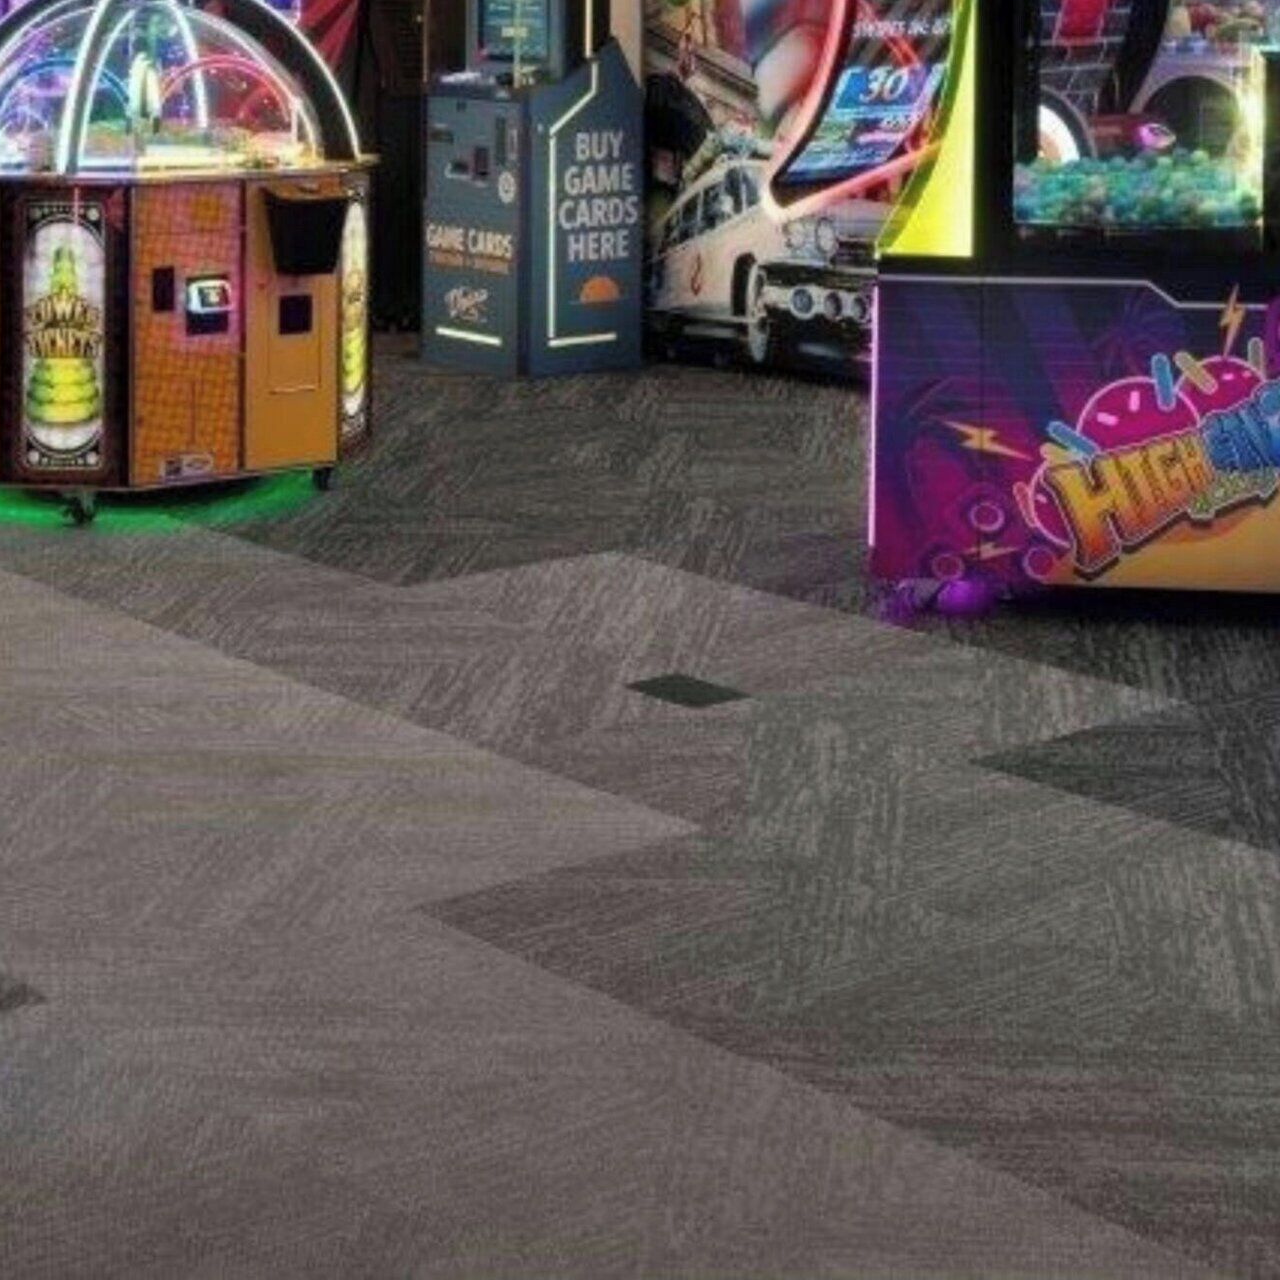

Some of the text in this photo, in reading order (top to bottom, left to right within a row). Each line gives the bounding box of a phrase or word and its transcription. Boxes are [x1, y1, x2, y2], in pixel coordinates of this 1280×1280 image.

[859, 65, 909, 102] 30
[575, 130, 624, 160] BUY
[563, 166, 633, 195] GAME
[558, 197, 639, 229] CARDS
[426, 224, 513, 260] GAME CARDS
[567, 229, 630, 263] HERE
